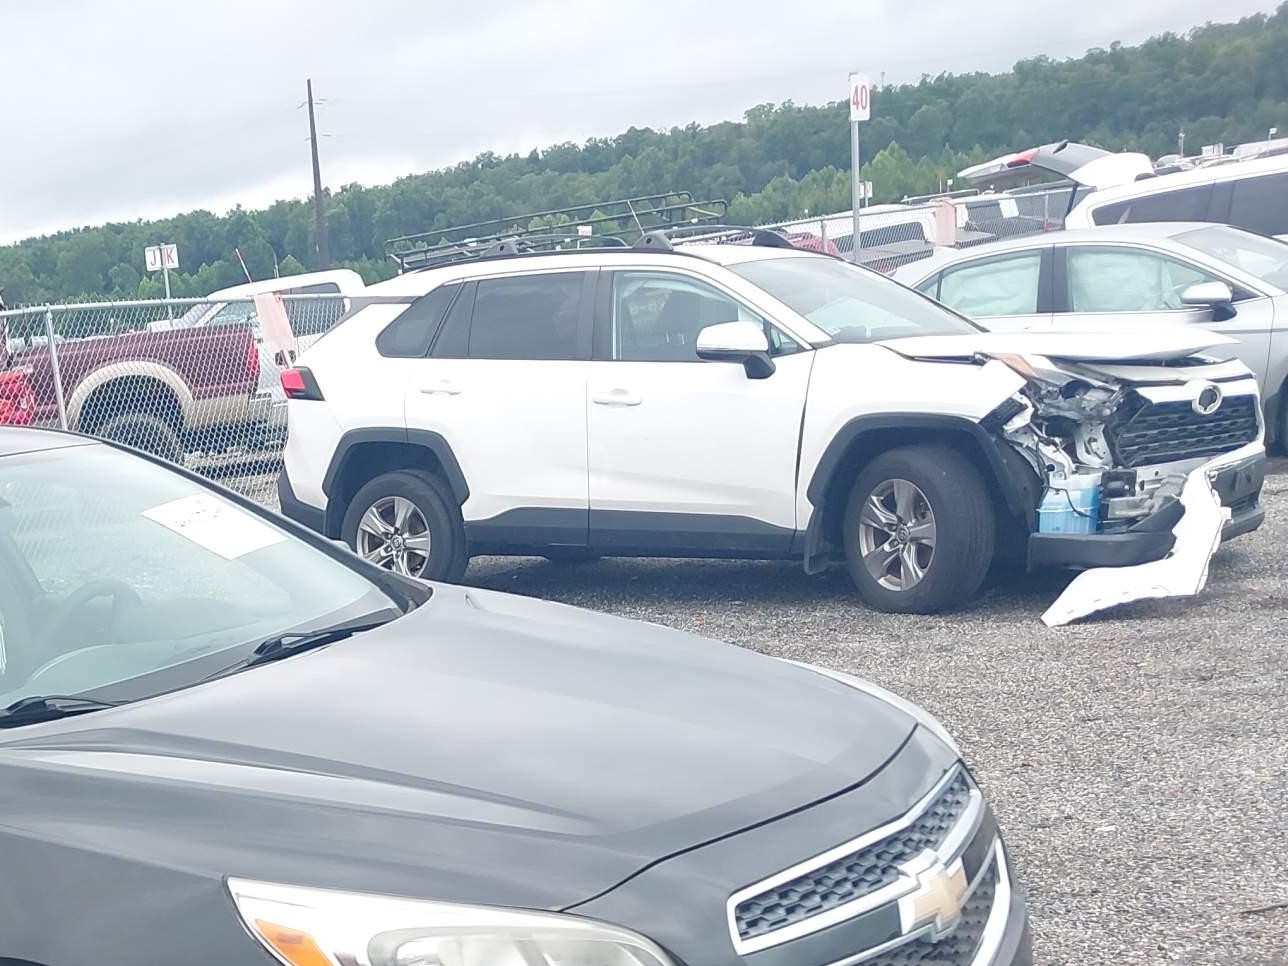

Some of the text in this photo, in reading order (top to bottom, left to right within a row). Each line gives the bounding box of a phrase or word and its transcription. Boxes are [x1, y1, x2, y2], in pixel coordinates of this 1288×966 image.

[852, 84, 868, 111] 40
[150, 247, 175, 266] J K
